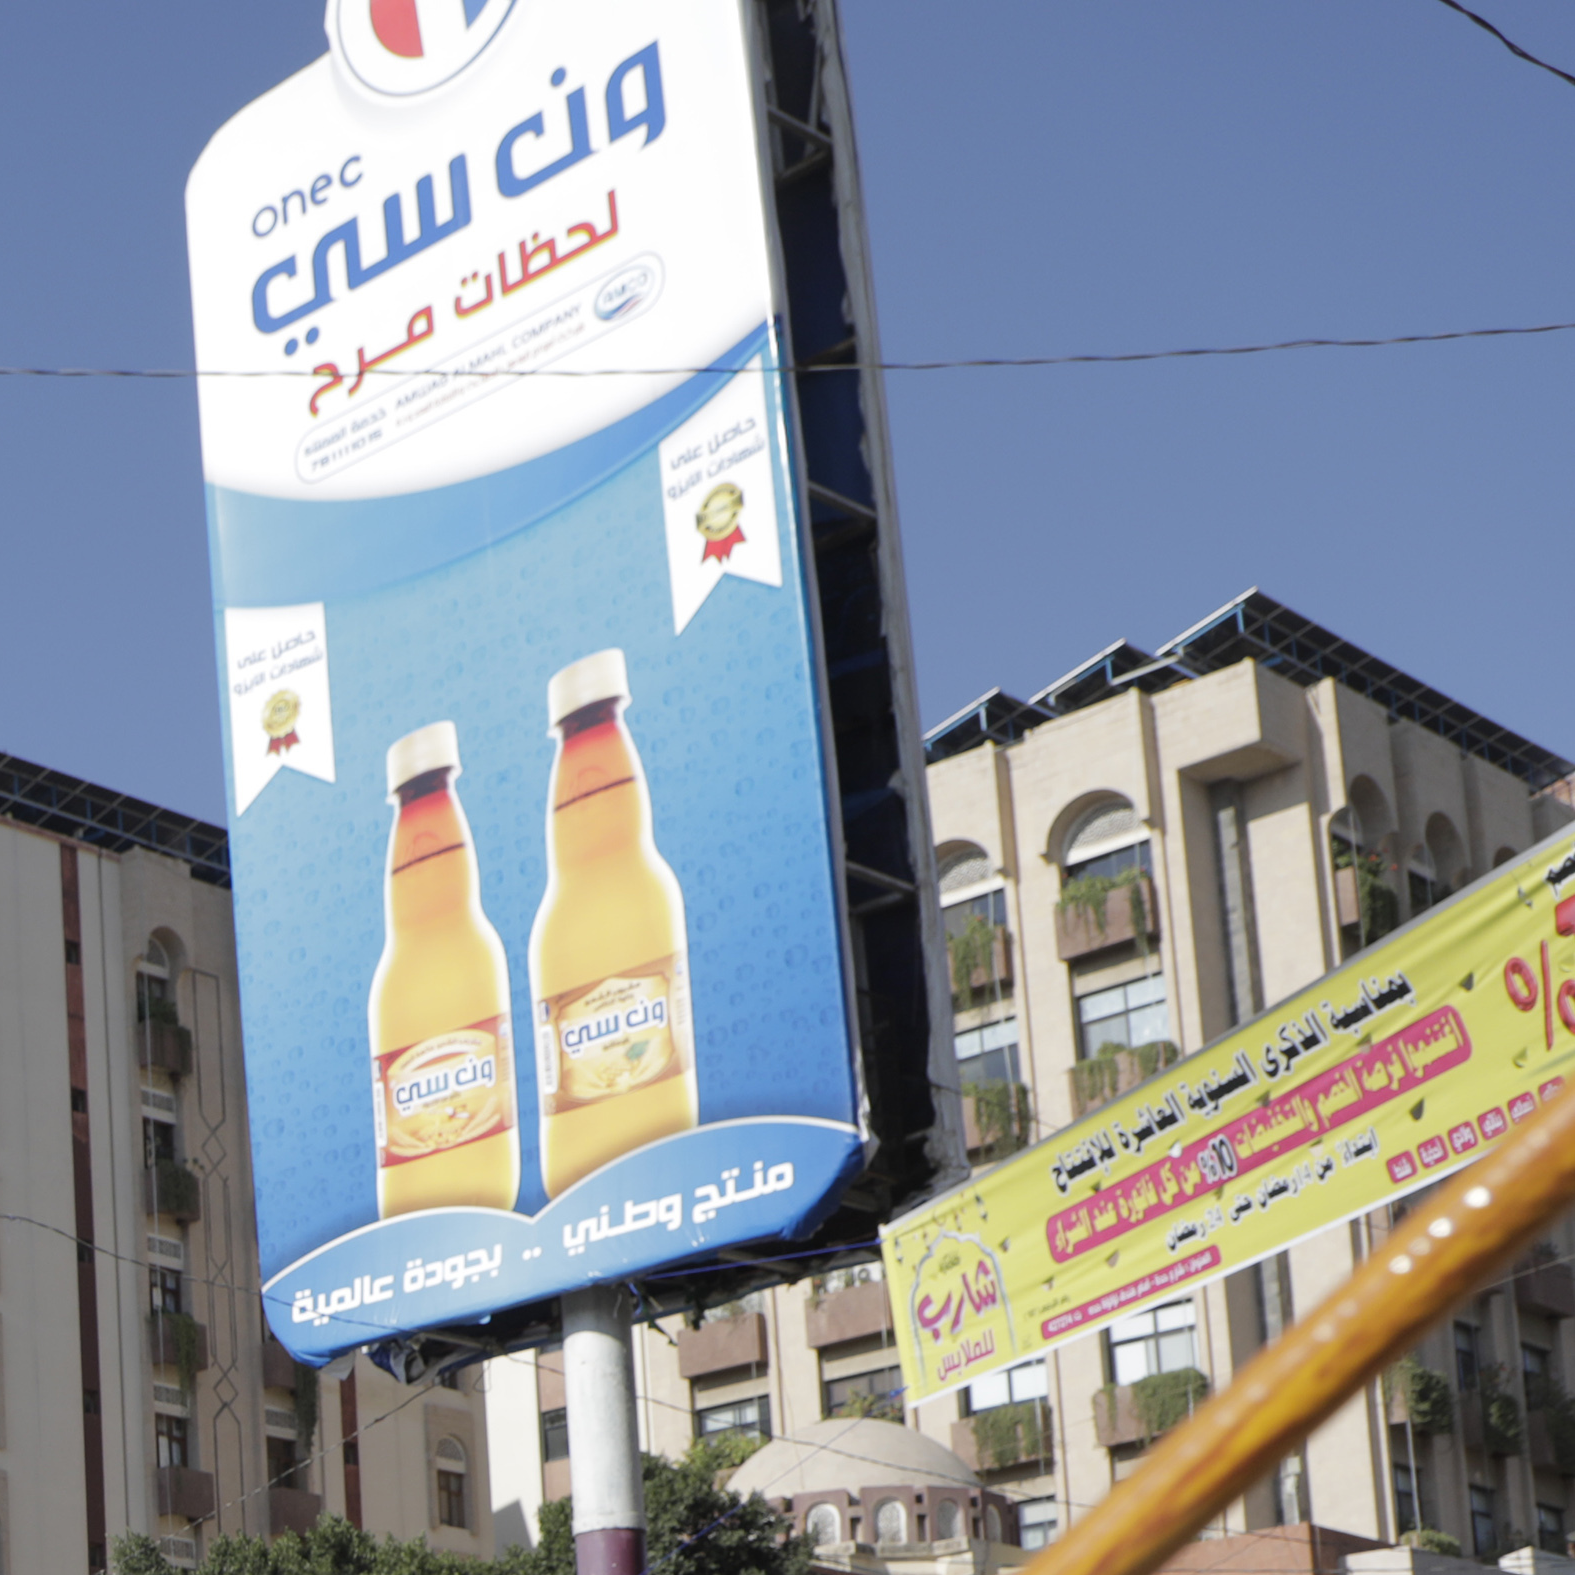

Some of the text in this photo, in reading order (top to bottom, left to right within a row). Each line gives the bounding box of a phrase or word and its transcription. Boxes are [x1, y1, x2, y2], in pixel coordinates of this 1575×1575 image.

[309, 188, 619, 418] لحظات مرح
[1321, 970, 1415, 1034] بمناسبة
[1262, 1010, 1328, 1078] الذكرى
[1357, 1046, 1406, 1091] فرصة
[1400, 1012, 1464, 1078] اغتنموا
[1182, 1050, 1257, 1118] السنوية
[1317, 1066, 1363, 1129] الخصم
[1114, 1092, 1186, 1154] العاشرة
[1235, 1095, 1320, 1159] والتخفيضات
[692, 1160, 795, 1224] منتج
[1159, 1162, 1180, 1205] كل
[1180, 1161, 1201, 1195] من
[1318, 1157, 1333, 1181] من
[563, 1192, 683, 1256] وطني
[1093, 1200, 1118, 1231] عند
[1115, 1175, 1158, 1223] فاتورة
[1055, 1207, 1092, 1253] الشراء
[1168, 1222, 1207, 1251] رمضان
[402, 1243, 502, 1295] بجودة
[291, 1274, 395, 1326] عالمية
[917, 1260, 996, 1341] شارب
[937, 1328, 994, 1381] للملابس
